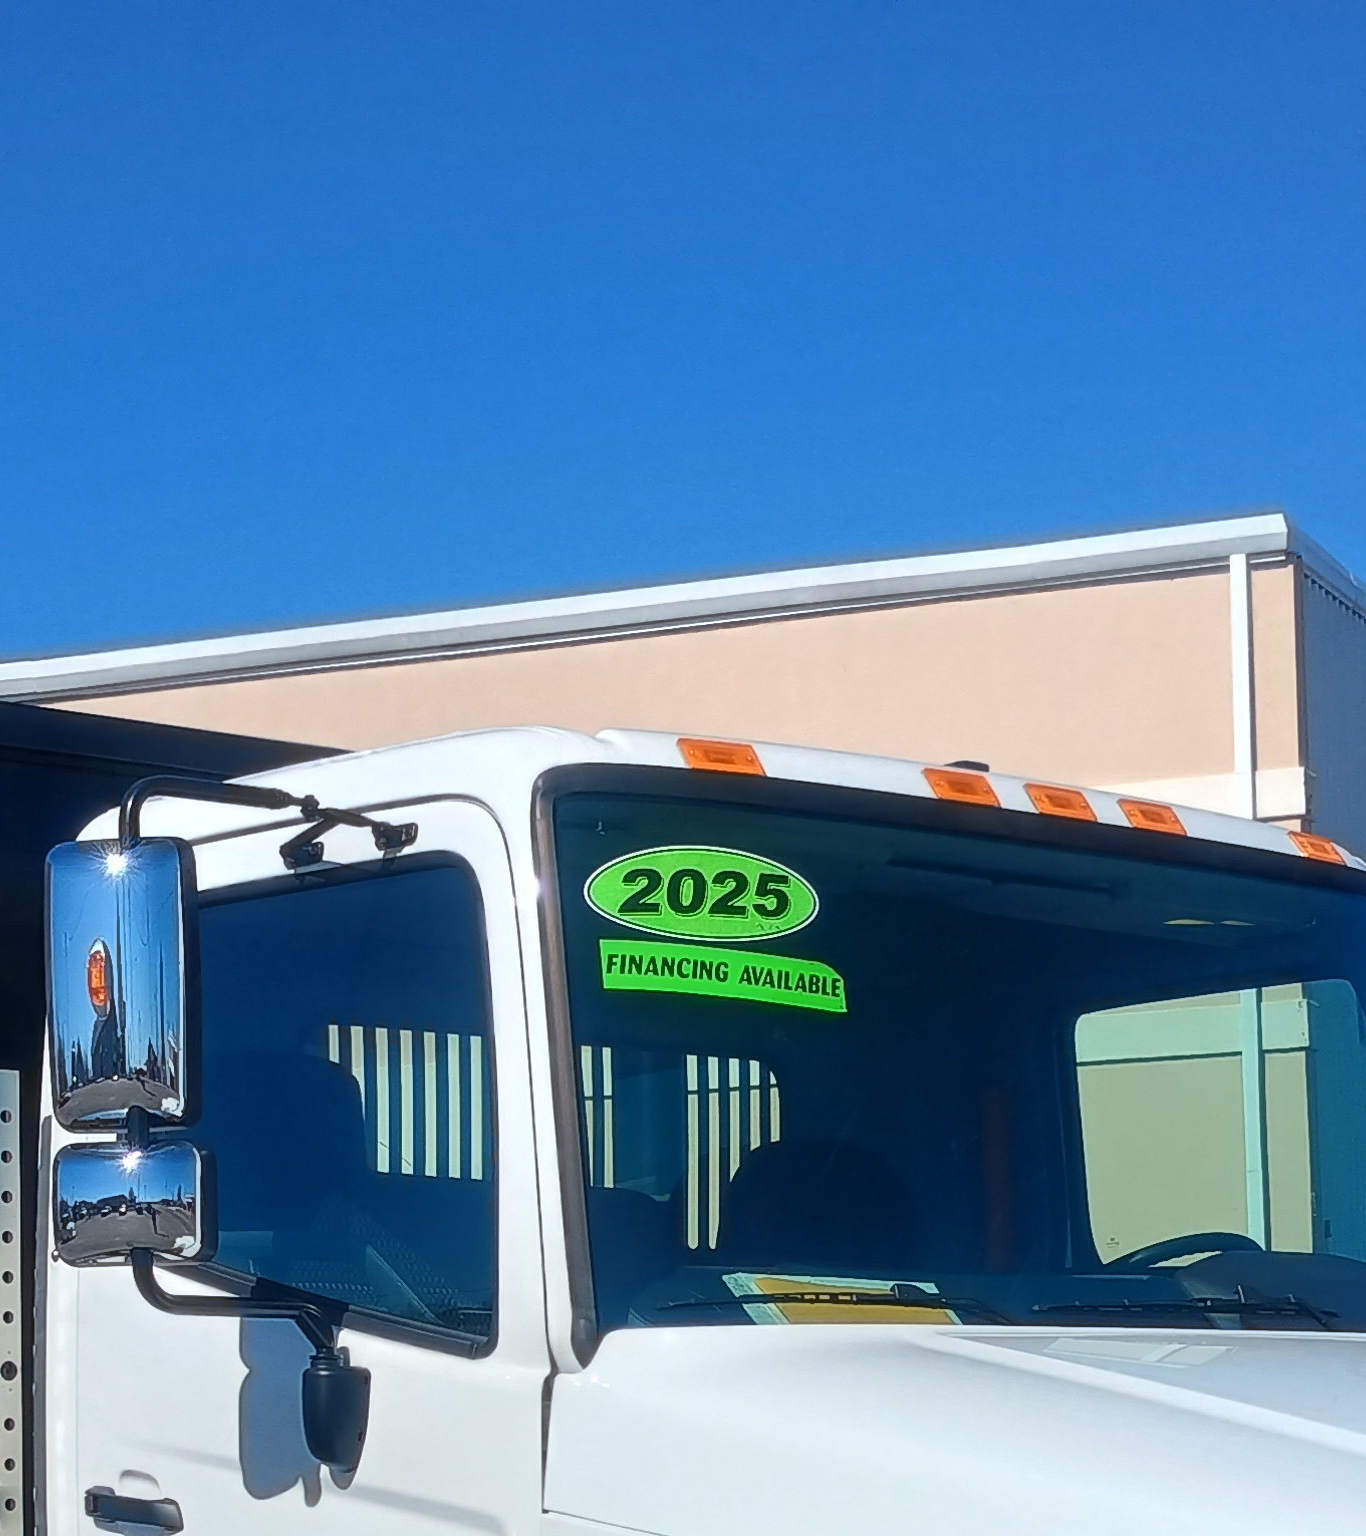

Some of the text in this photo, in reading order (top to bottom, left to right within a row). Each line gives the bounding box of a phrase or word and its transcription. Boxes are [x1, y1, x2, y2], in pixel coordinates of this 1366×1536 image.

[617, 868, 792, 921] 2025
[605, 953, 841, 998] FINANCING AVAILABLE
